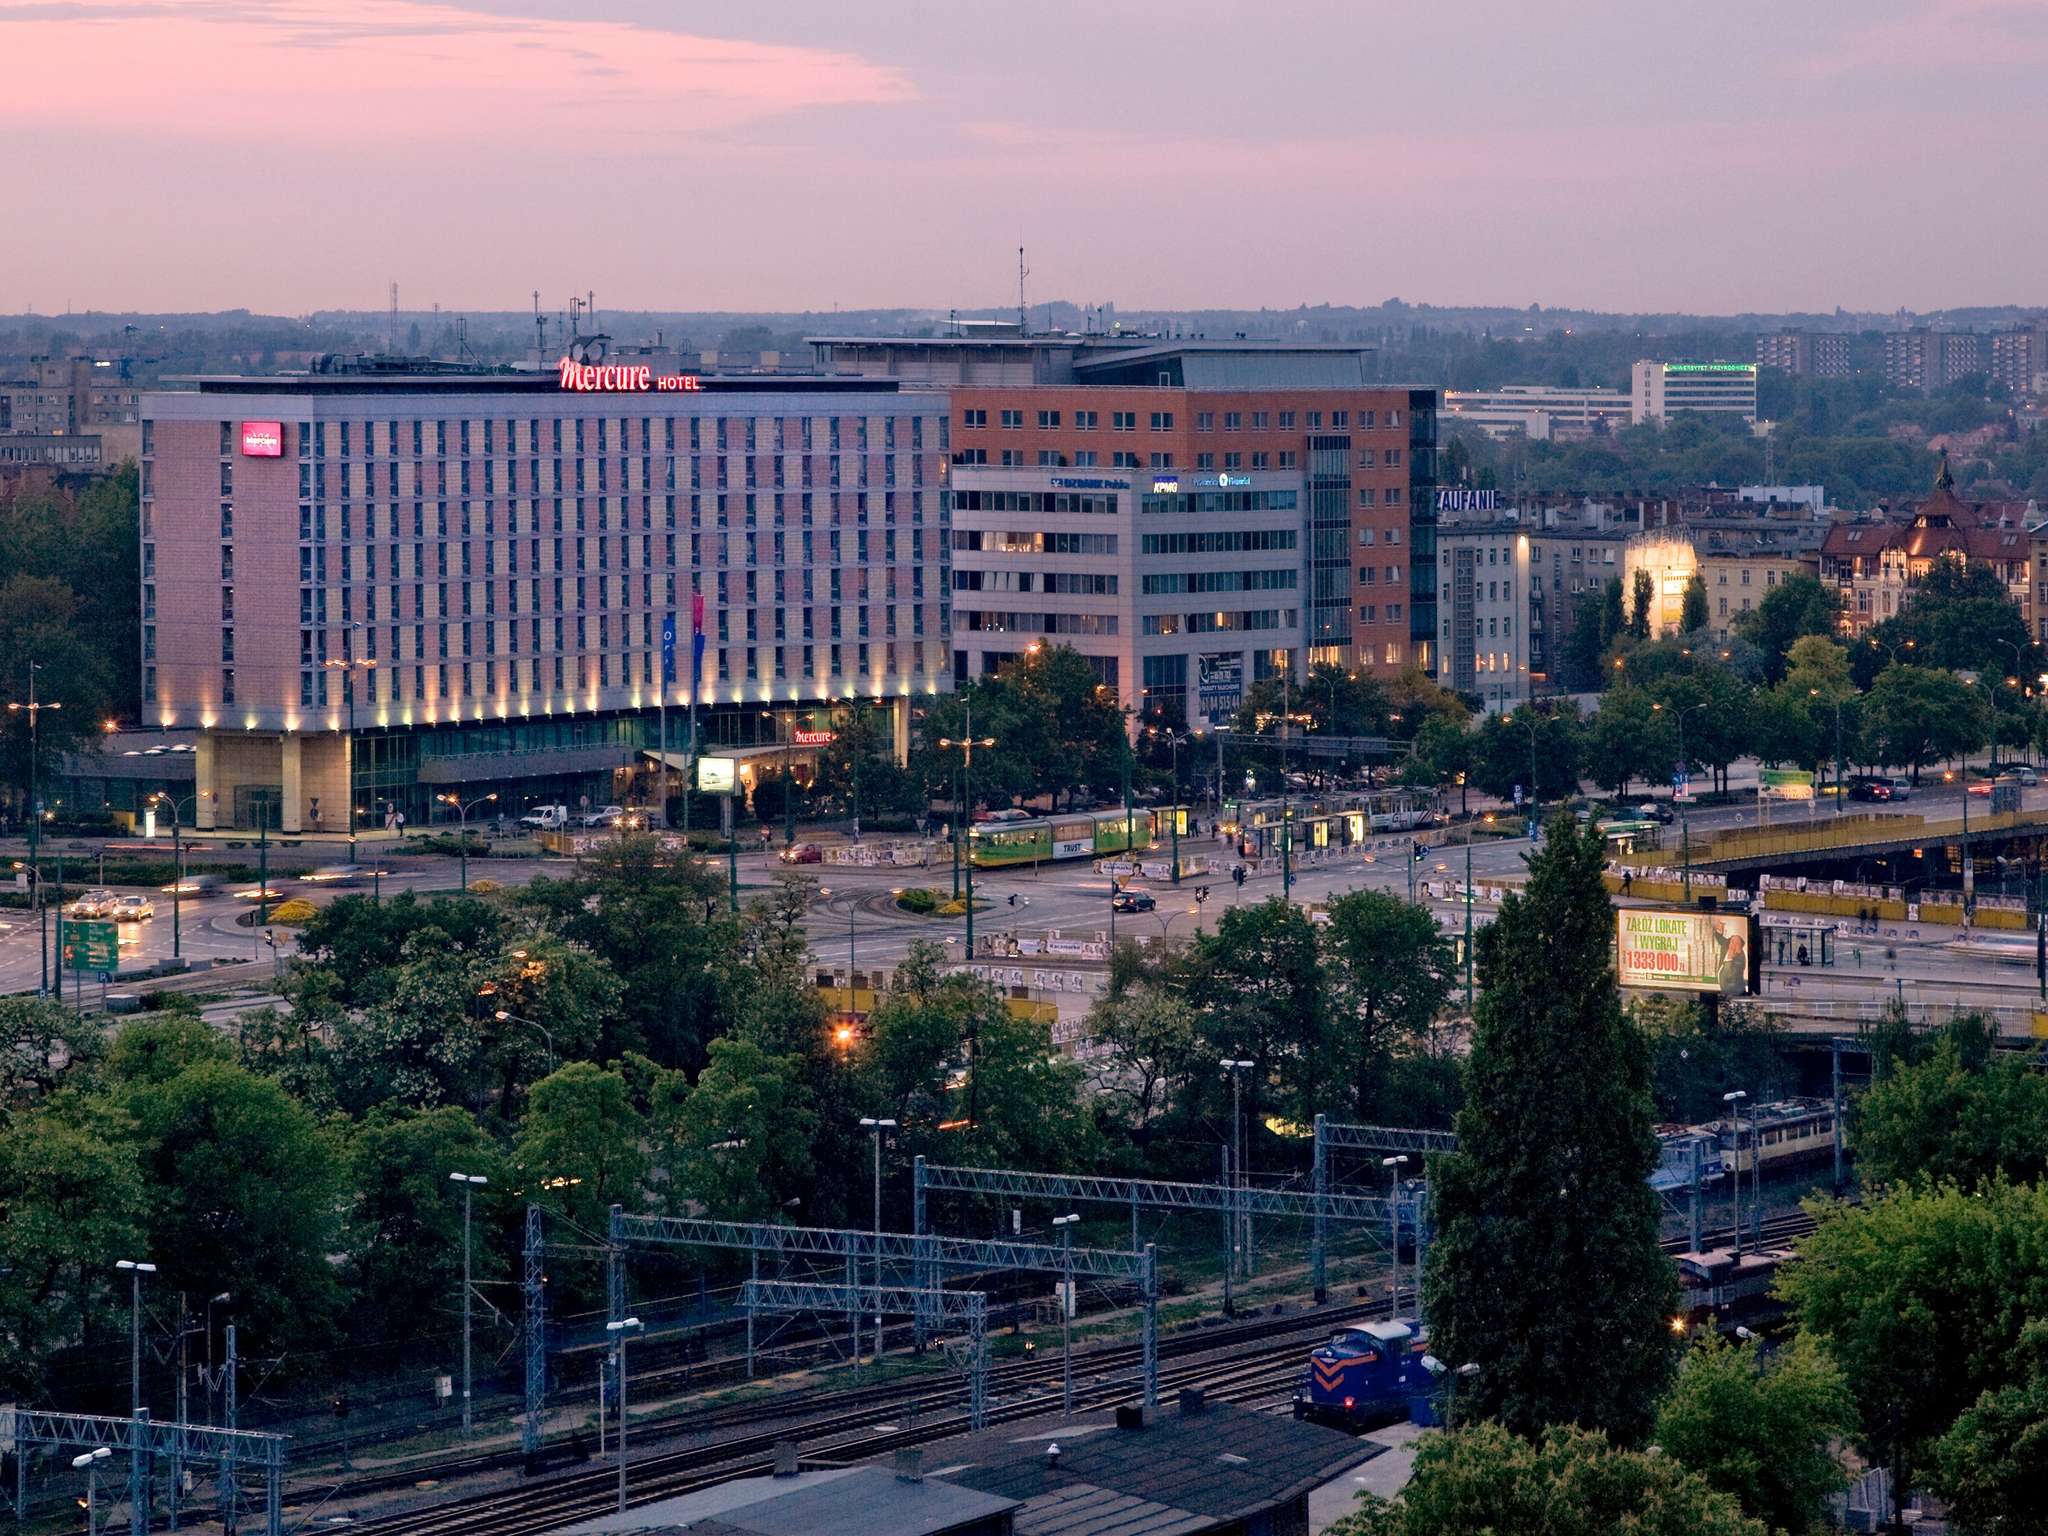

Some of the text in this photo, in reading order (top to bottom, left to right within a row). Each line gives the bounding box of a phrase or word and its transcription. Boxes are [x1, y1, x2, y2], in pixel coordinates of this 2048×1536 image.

[559, 356, 700, 391] Mercure HOTEL
[1153, 482, 1178, 494] KPMG
[1435, 490, 1505, 511] ZAUFANIE
[795, 730, 831, 743] Mercure
[1064, 843, 1081, 853] TRUST
[1655, 918, 1687, 937] LOKATĘ
[1640, 935, 1678, 952] WYGRAJ
